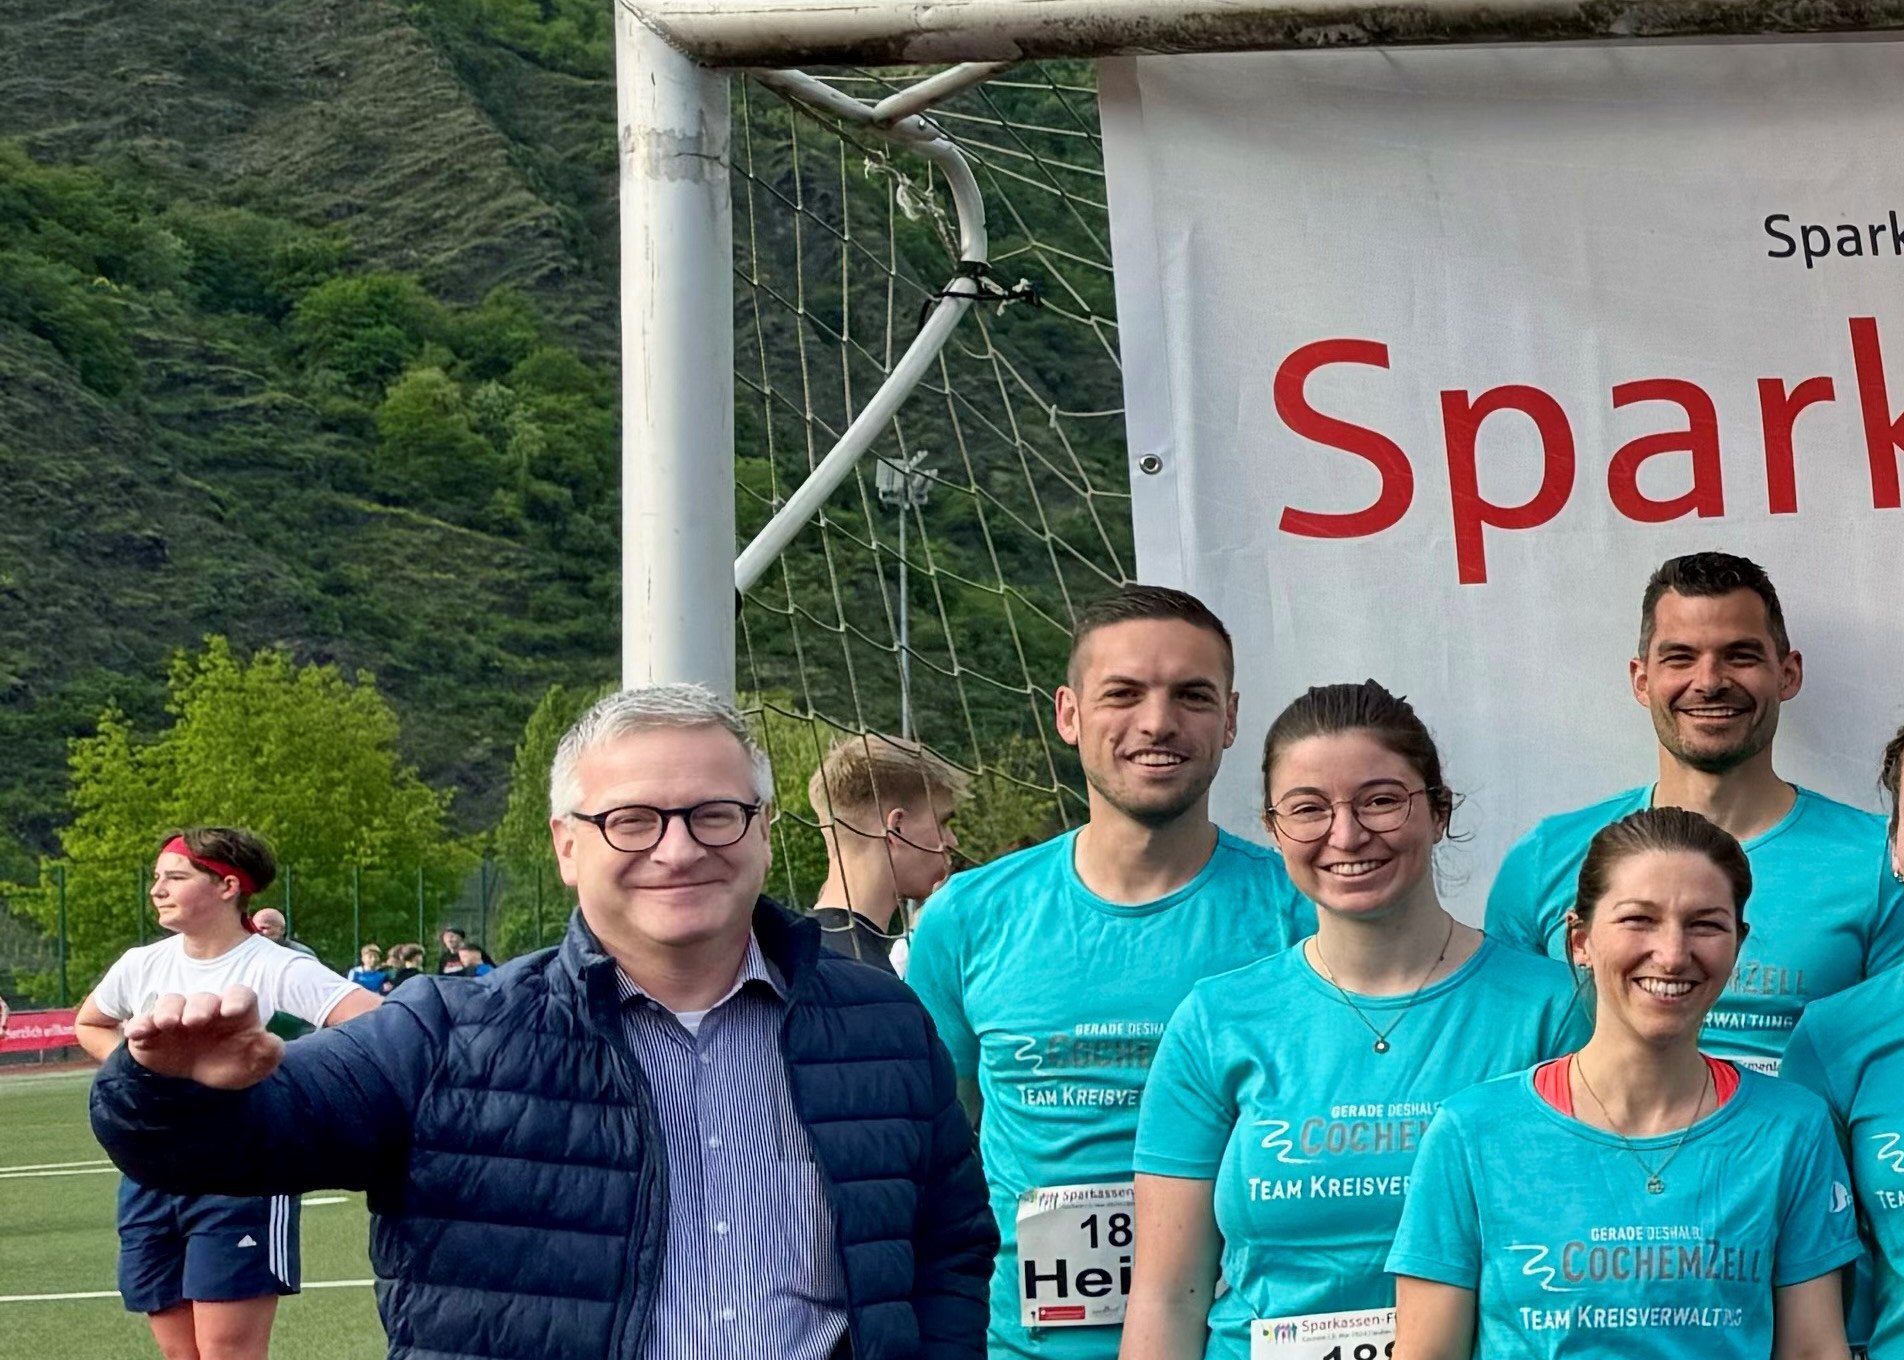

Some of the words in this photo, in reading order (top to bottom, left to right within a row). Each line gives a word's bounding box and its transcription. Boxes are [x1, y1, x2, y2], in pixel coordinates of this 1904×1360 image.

[1016, 1084, 1057, 1106] TEAM
[1331, 1104, 1384, 1119] GERADE
[1063, 1187, 1134, 1202] Sparkassen
[1249, 1176, 1302, 1201] TEAM
[1080, 1213, 1132, 1249] 18
[1590, 1225, 1644, 1242] GERADE
[1561, 1238, 1761, 1284] COCHEMZELL
[1024, 1255, 1131, 1299] Hei
[1519, 1306, 1570, 1331] TEAM
[1577, 1303, 1744, 1329] KREISVERWALTUNG
